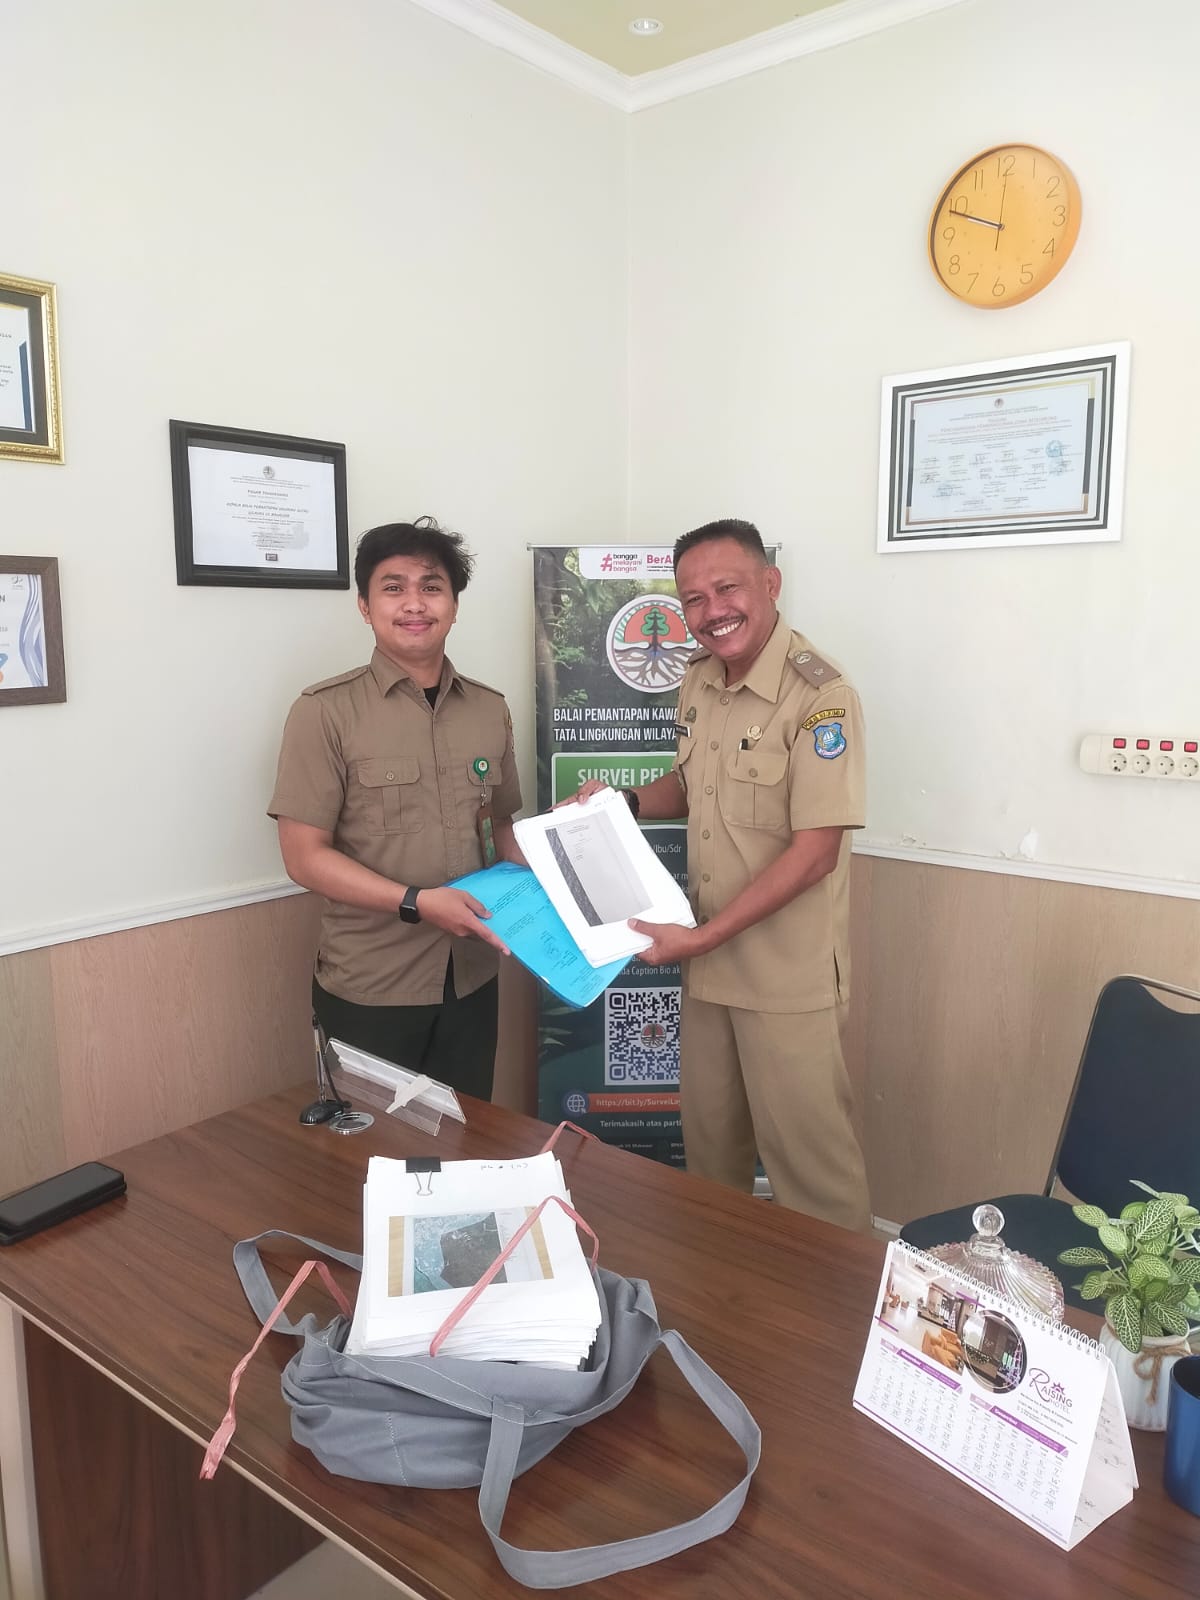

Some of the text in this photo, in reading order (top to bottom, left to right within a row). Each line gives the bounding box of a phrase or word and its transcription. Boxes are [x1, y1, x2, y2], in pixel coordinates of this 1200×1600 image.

[997, 154, 1017, 179] 12
[1032, 158, 1037, 179] 1
[973, 168, 985, 192] 11
[1046, 175, 1061, 200] 2
[949, 195, 969, 217] 10
[1052, 205, 1066, 227] 3
[942, 226, 956, 248] 9
[1041, 237, 1055, 258] 4
[948, 254, 961, 276] 8
[1019, 262, 1034, 285] 5
[967, 272, 980, 294] 7
[991, 276, 1006, 297] 6
[612, 553, 639, 561] bangga
[612, 559, 642, 567] melayani
[647, 554, 674, 565] BerA
[553, 707, 583, 721] BALAI
[585, 707, 650, 721] PEMANTAPAN
[554, 728, 577, 741] TATA
[579, 727, 641, 741] LINGKUNGAN
[577, 767, 636, 787] SURVEI
[630, 966, 658, 977] Caption
[659, 965, 671, 975] Bio
[599, 1119, 645, 1128] Terimakasih
[646, 1120, 661, 1128] atas
[1029, 1367, 1073, 1408] RAISING
[1049, 1398, 1071, 1414] HOTEL
